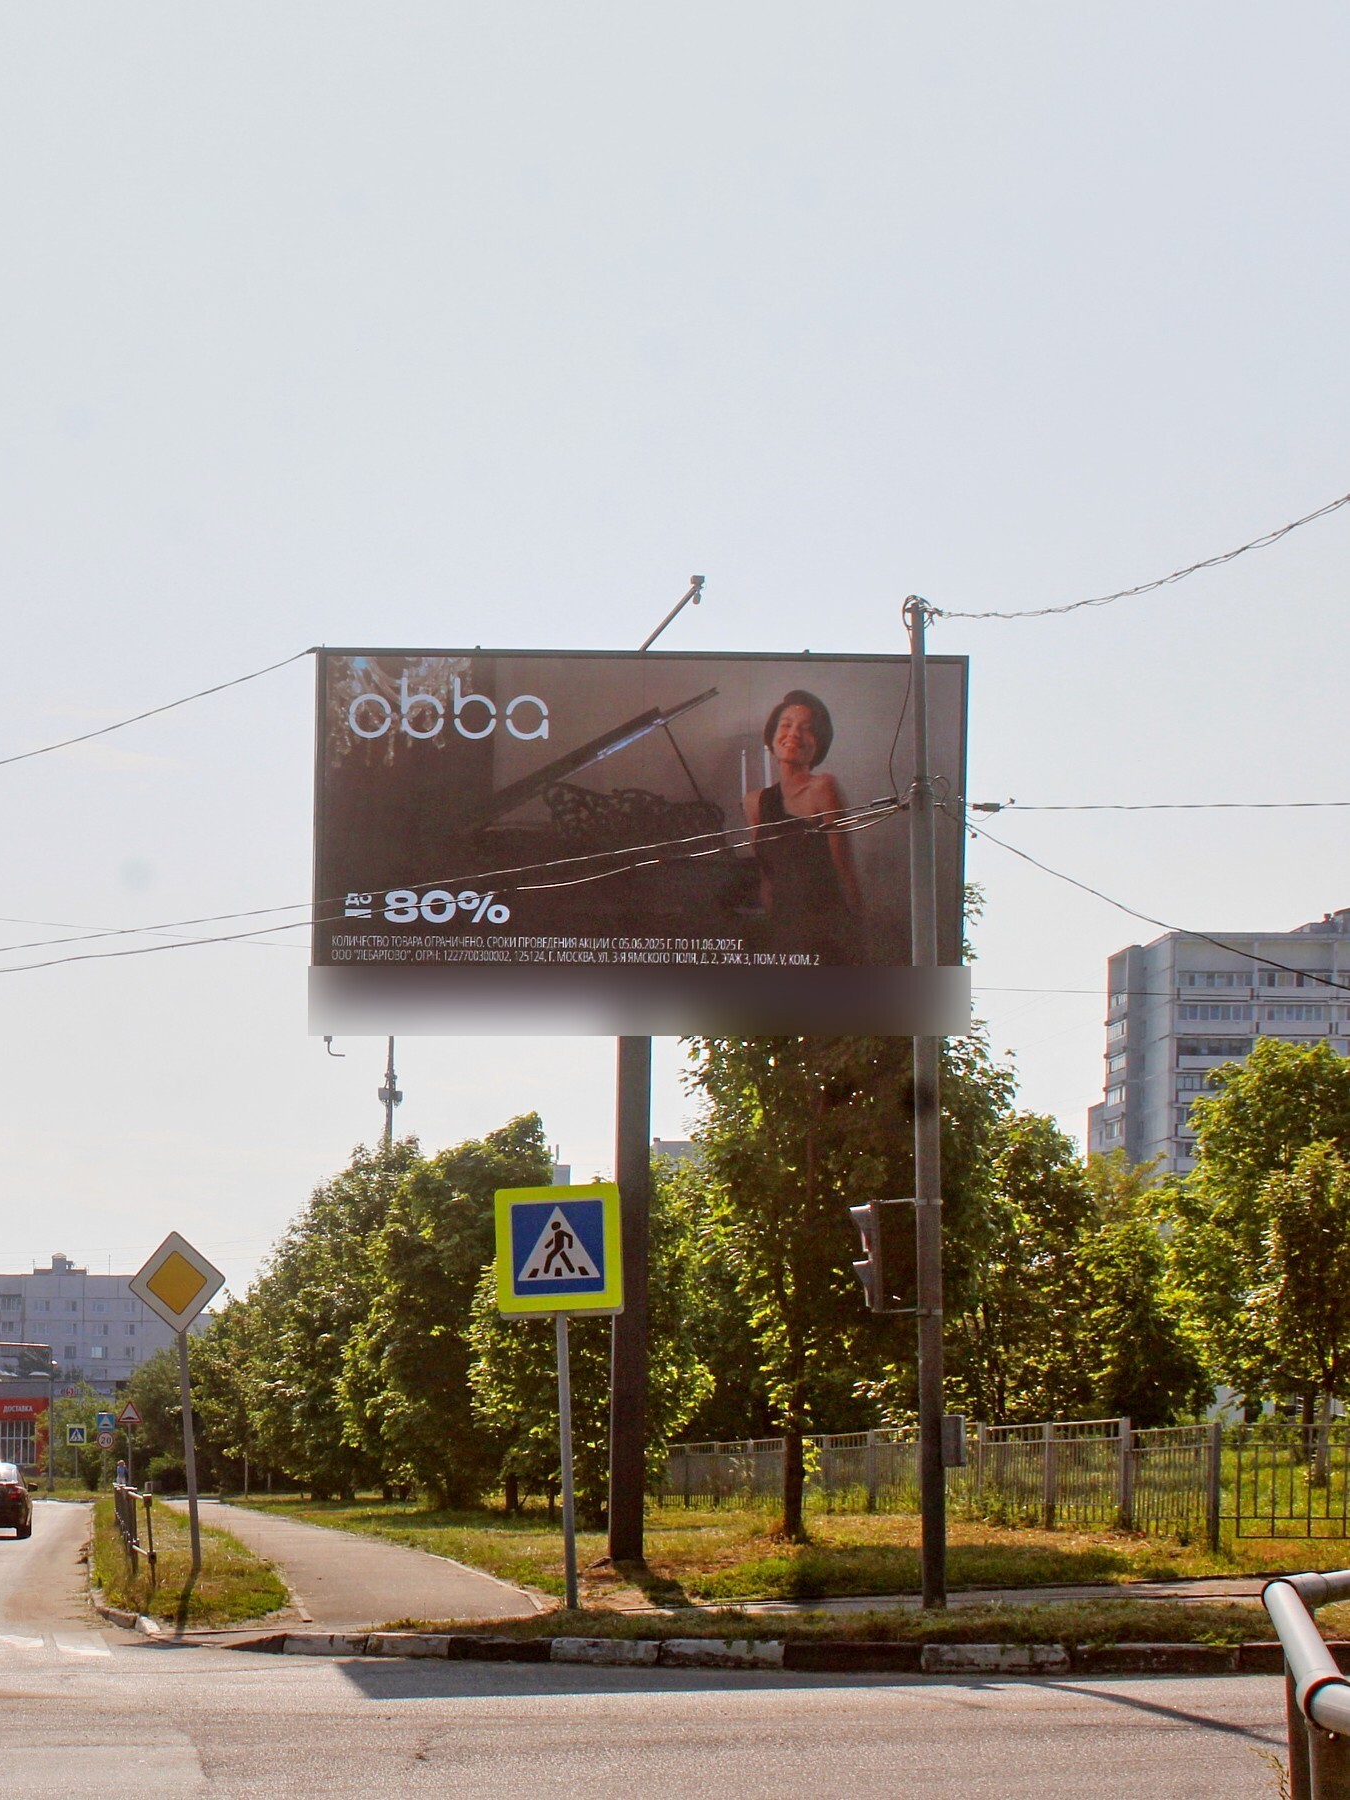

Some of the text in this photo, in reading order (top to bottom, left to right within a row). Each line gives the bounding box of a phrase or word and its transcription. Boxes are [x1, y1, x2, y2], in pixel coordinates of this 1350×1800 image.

[349, 676, 549, 740] obba
[331, 935, 390, 948] КОЛИЧЕСТВО
[391, 935, 423, 948] ТОВАРА
[486, 936, 517, 949] СРОКИ
[518, 936, 577, 950] ПРОВЕДЕНИЯ
[578, 937, 610, 950] АКЦИИ
[674, 938, 688, 950] ПО
[691, 939, 736, 950] 11.06.2025
[331, 950, 352, 961] ООО
[627, 952, 671, 964] ЯМСКОГО
[100, 1437, 112, 1445] 20
